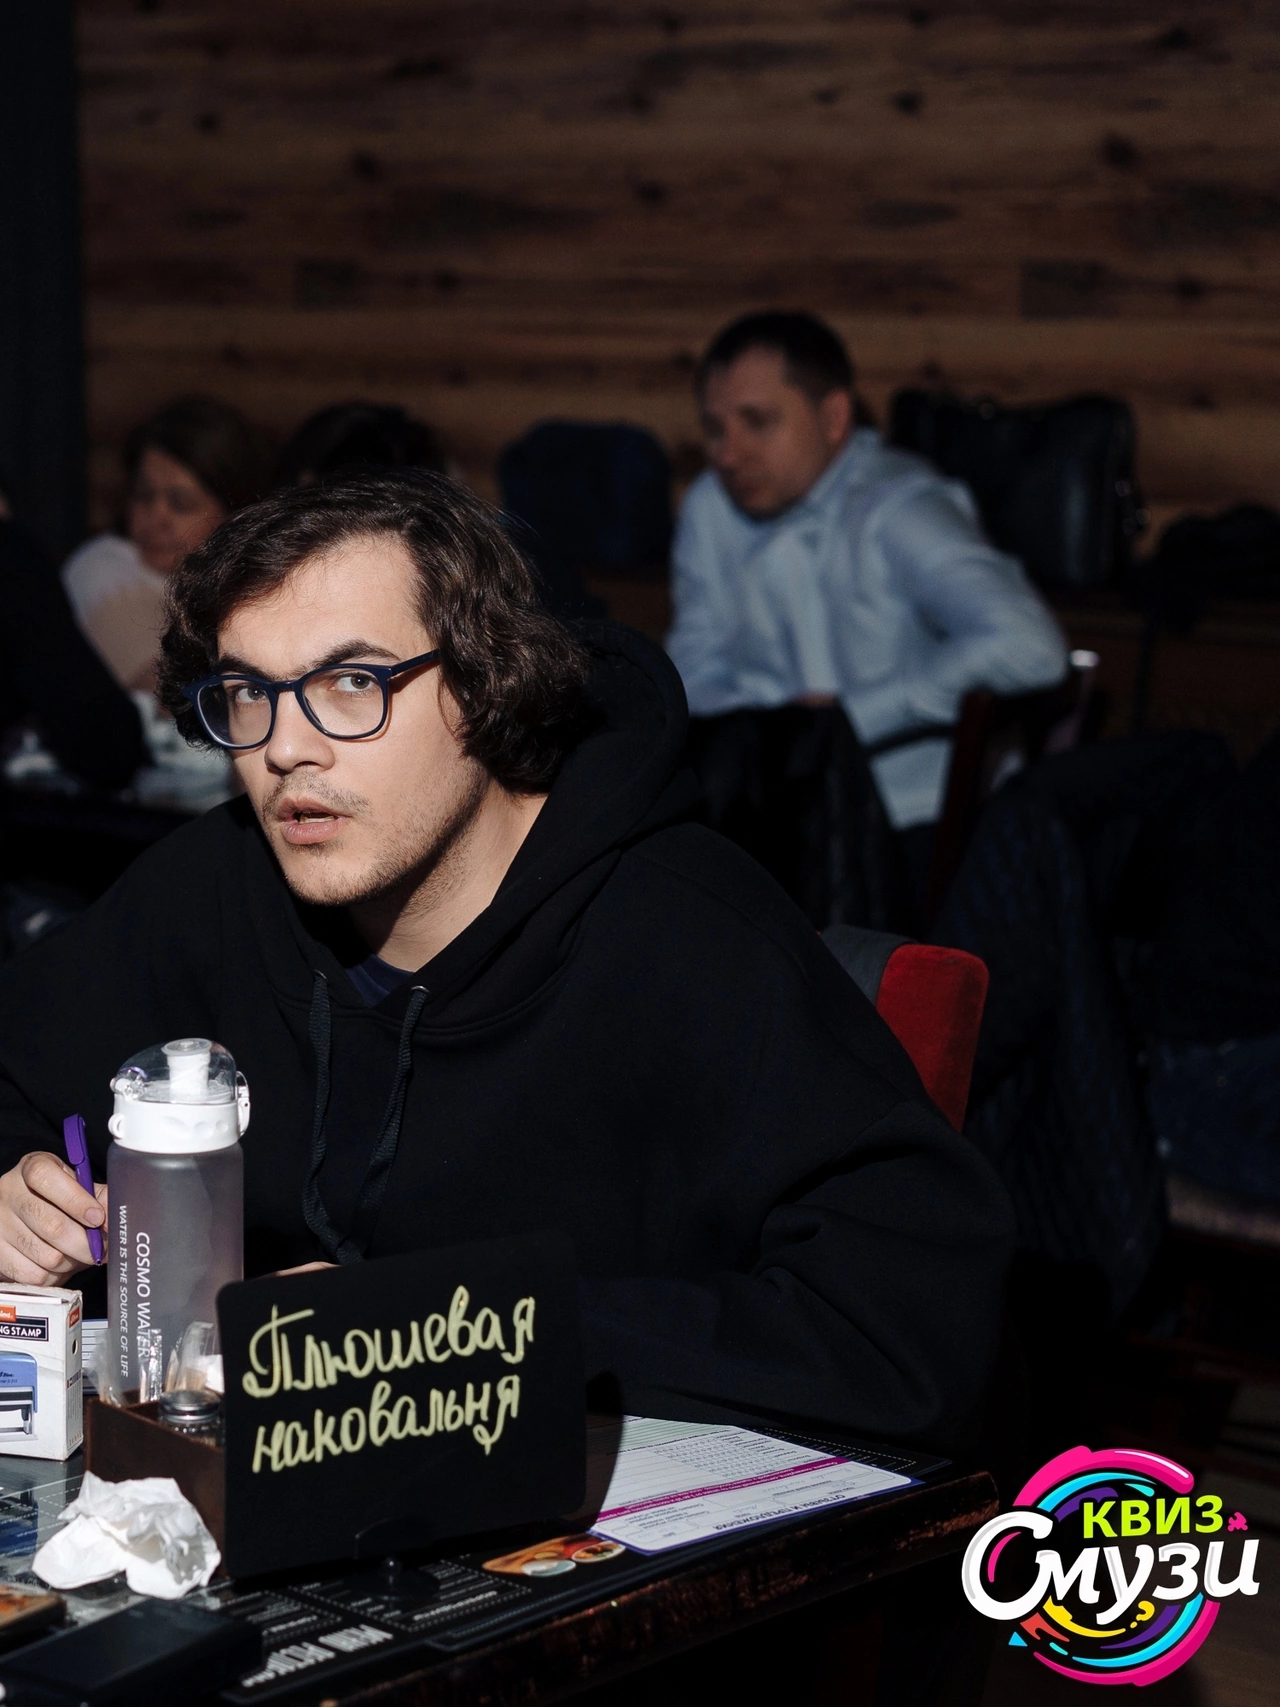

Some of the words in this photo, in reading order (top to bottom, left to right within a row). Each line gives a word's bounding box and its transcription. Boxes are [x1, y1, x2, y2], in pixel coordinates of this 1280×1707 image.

[119, 1205, 128, 1246] WATER
[119, 1247, 128, 1259] IS
[119, 1260, 128, 1284] THE
[136, 1231, 151, 1298] COSMO
[120, 1286, 129, 1334] SOURCE
[136, 1301, 152, 1359] WATER
[11, 1327, 42, 1338] STAMP
[120, 1335, 129, 1353] OF
[242, 1284, 536, 1398] Плюшевая
[120, 1354, 129, 1378] LIFE
[252, 1374, 521, 1474] наковальня
